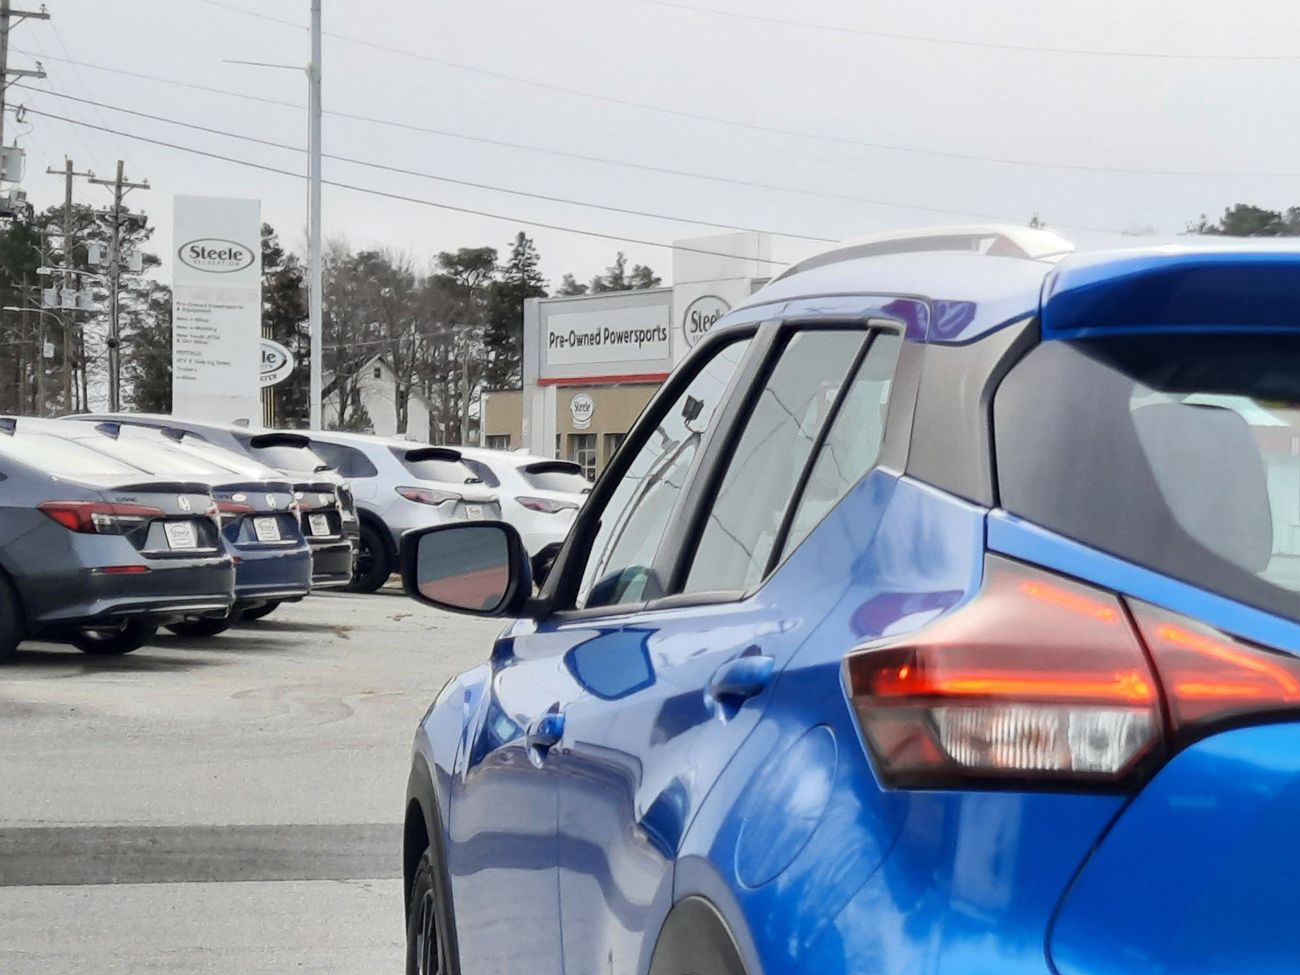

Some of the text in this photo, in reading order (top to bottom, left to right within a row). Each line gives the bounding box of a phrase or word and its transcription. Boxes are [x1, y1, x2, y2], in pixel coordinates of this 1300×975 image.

[189, 245, 243, 261] Steele
[690, 309, 724, 333] Steel
[549, 323, 667, 349] Pre-Owned Powersports
